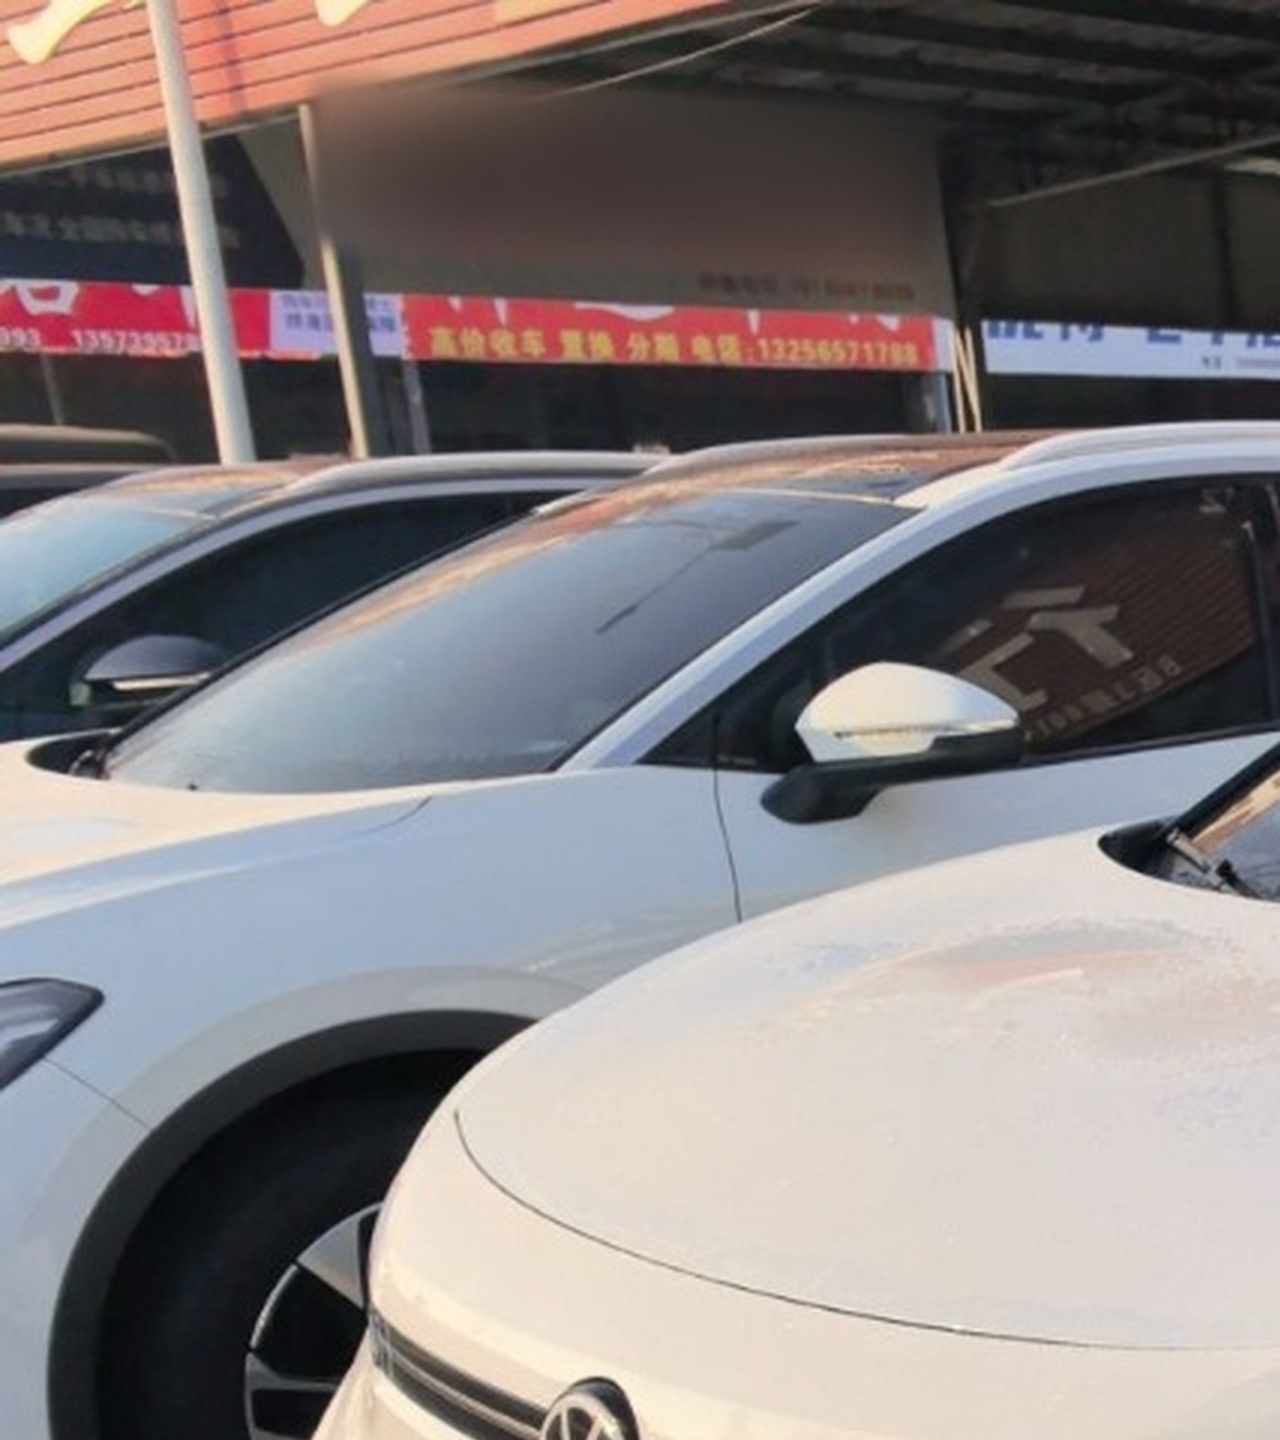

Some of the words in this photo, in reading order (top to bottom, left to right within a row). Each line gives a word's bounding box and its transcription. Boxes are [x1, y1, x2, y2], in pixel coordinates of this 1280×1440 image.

[430, 325, 546, 359] 高价收车
[560, 328, 615, 361] 置换
